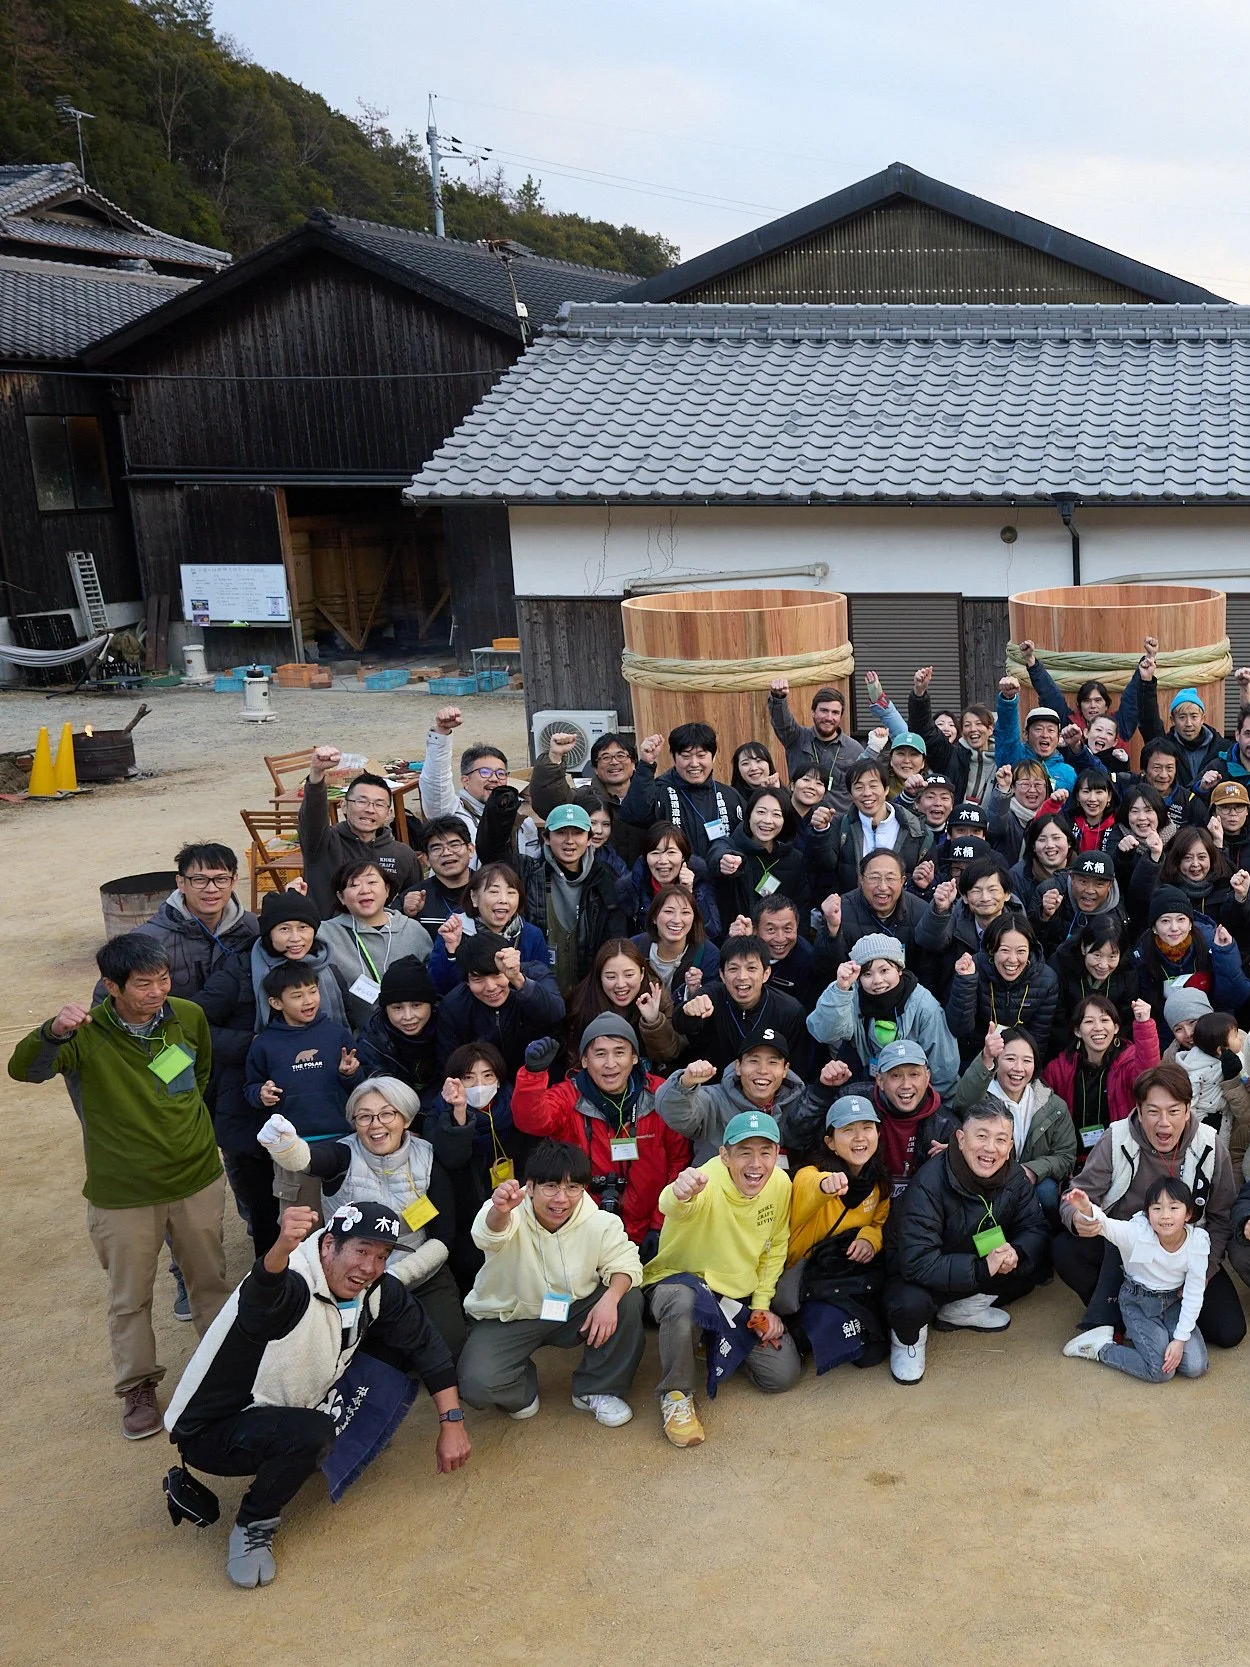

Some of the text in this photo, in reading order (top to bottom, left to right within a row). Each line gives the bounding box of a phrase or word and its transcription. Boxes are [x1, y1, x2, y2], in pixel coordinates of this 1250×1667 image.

[959, 809, 980, 822] 木桶
[953, 845, 974, 858] 木桶
[1082, 860, 1105, 874] 木桶
[762, 1028, 775, 1040] S
